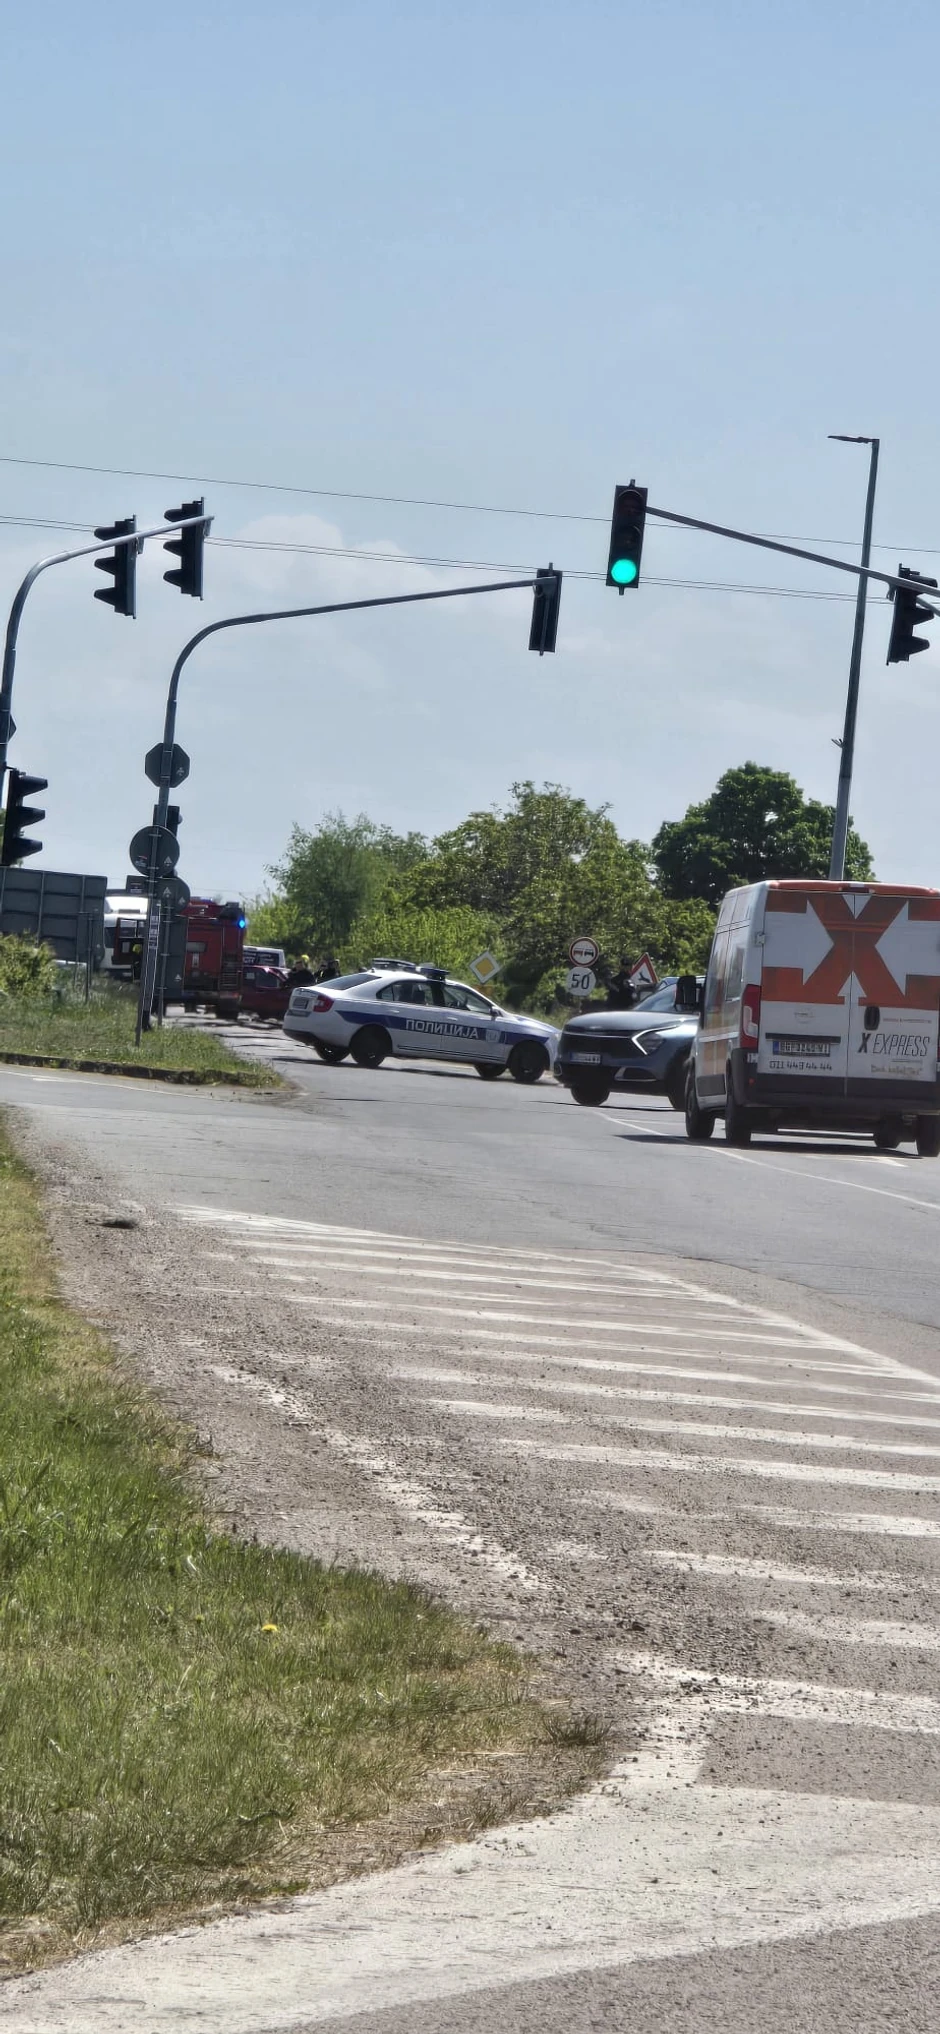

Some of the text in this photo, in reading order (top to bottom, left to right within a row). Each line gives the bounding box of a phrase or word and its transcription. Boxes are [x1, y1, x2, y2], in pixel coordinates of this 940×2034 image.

[571, 972, 590, 990] 50
[406, 1019, 479, 1039] ПОЛИЦИЈА
[857, 1032, 931, 1057] X EXPRESS
